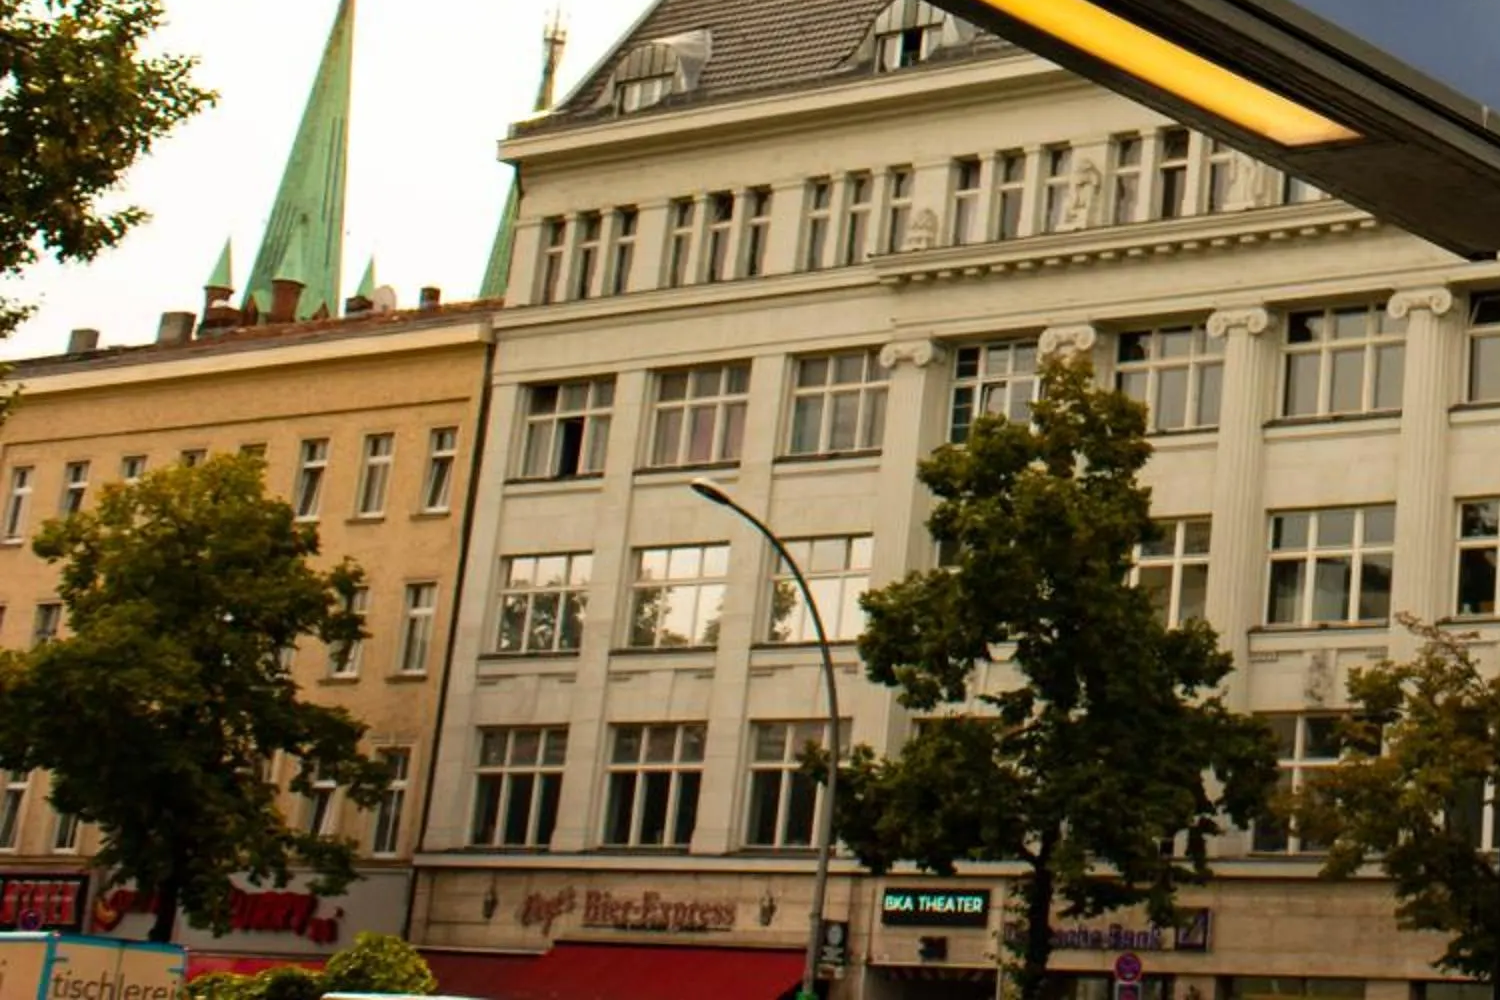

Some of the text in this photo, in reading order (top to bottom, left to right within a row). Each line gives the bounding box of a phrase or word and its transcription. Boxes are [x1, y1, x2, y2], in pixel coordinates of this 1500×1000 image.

[884, 895, 983, 914] BKA THEATER
[52, 968, 178, 1000] tischlerei
